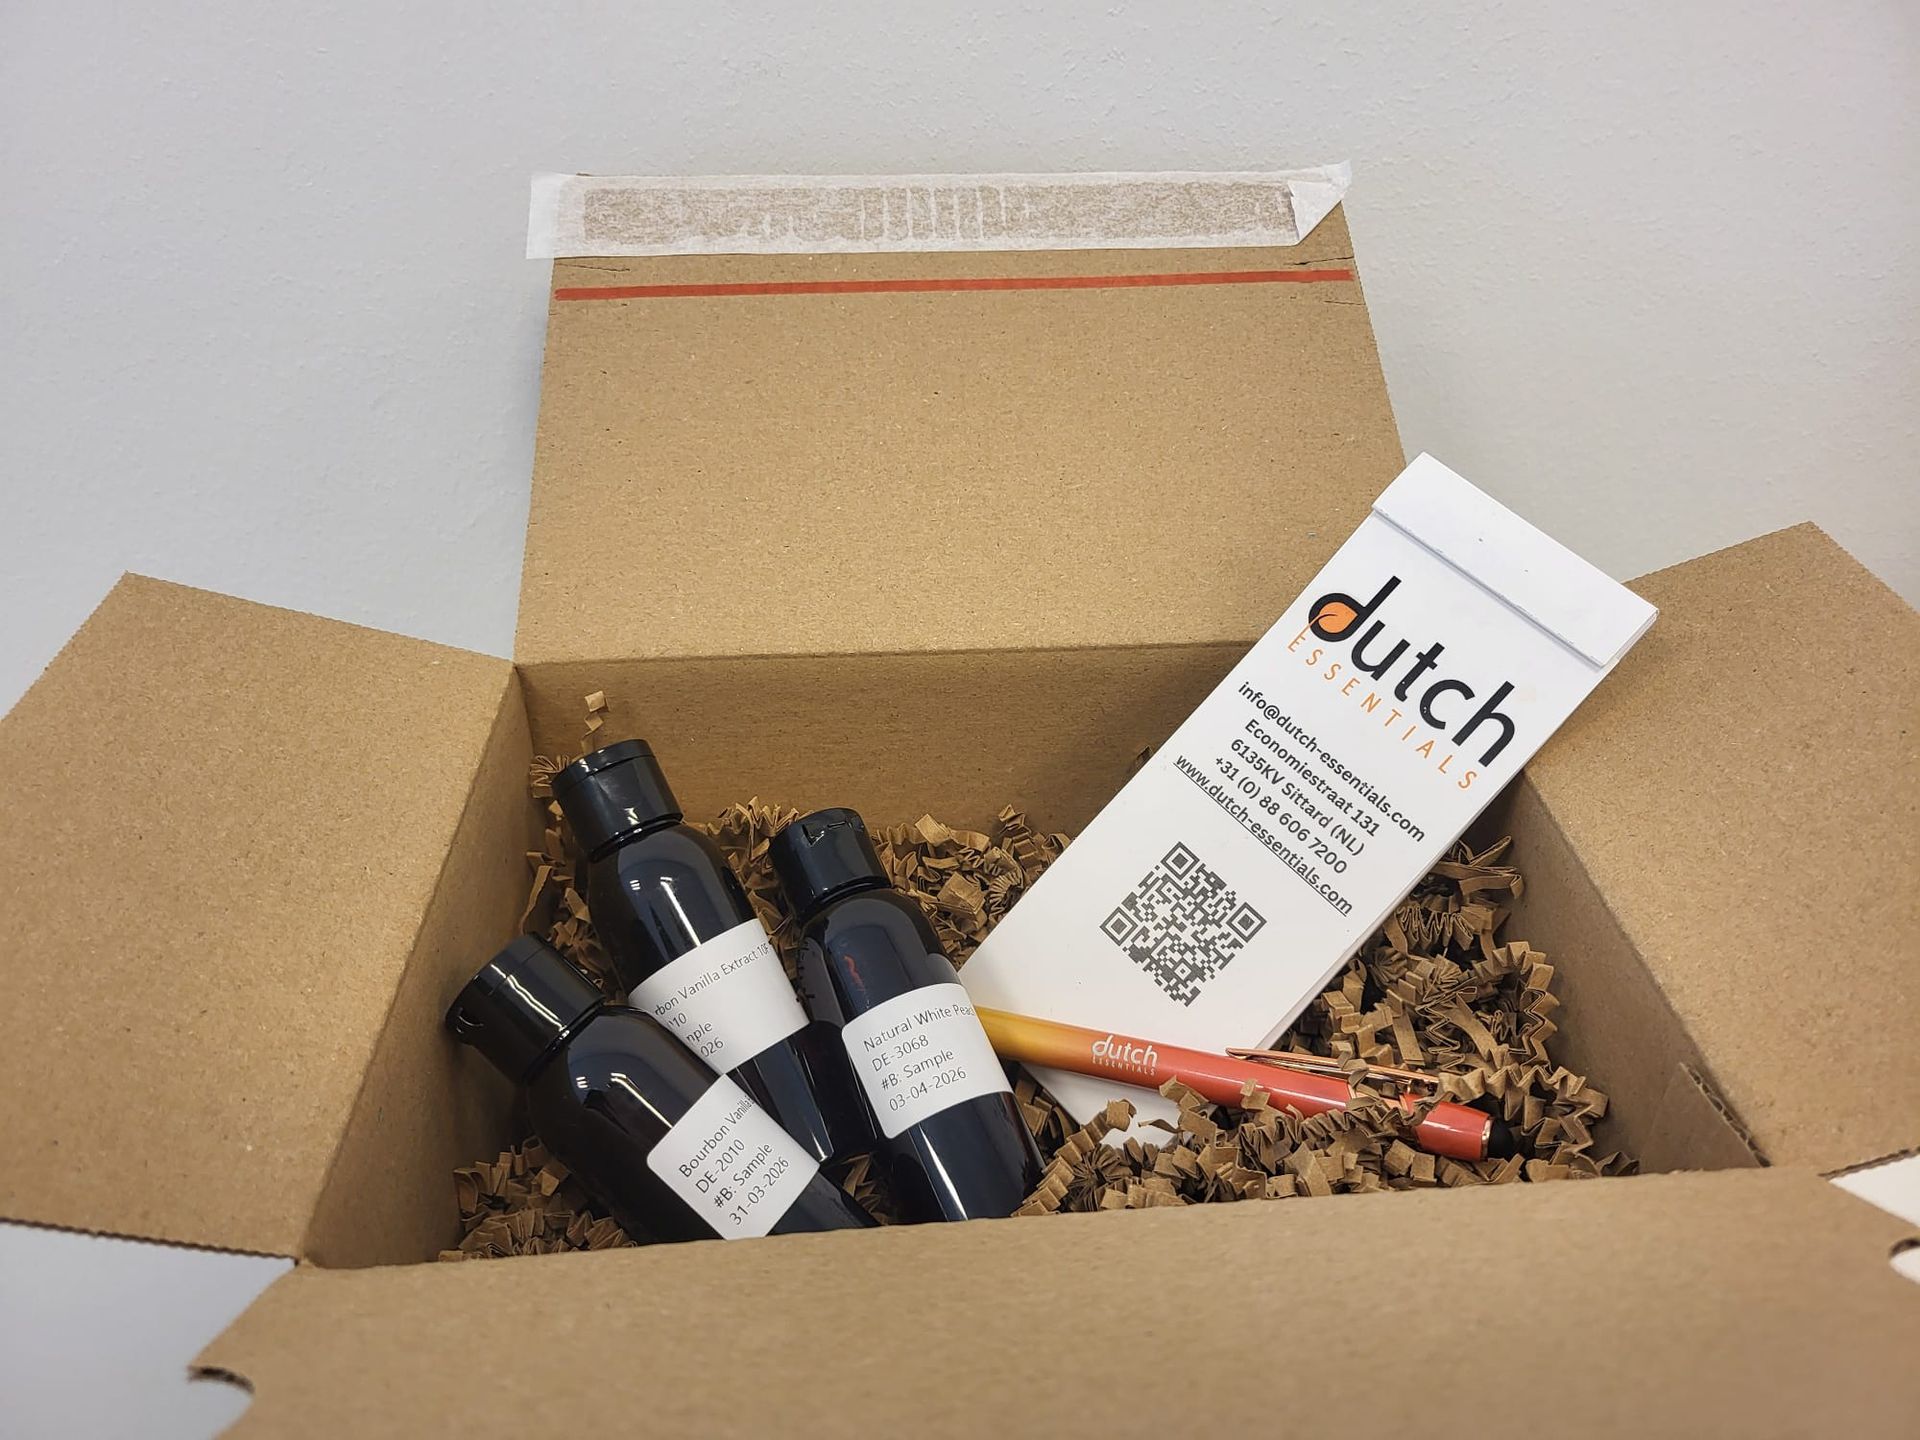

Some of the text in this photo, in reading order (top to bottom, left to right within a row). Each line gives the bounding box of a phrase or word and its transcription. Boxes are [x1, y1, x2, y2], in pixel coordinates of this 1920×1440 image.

[1308, 575, 1515, 767] dutch
[1287, 633, 1477, 789] ESSENTIALS
[1238, 681, 1425, 842] info@dutch-essentials.com
[1245, 719, 1381, 837] Economiestraat 131
[1215, 756, 1348, 874] +31 (0) 88 606 7200
[1231, 738, 1366, 857] 6135KV Sittard (NL)
[1174, 755, 1353, 916] www.dutch-essentials.com
[655, 997, 679, 1016] rbon
[677, 972, 721, 999] Vanilla
[720, 950, 758, 976] Extract
[863, 1004, 975, 1052] Natural White Peac
[872, 1034, 929, 1072] DE-3068
[1092, 1034, 1158, 1067] dutch
[881, 1050, 954, 1091] #B: Sample
[889, 1066, 967, 1112] 03-04-2026
[679, 1125, 730, 1178] Bourbon
[695, 1139, 745, 1194] DE-2010
[713, 1143, 773, 1208] #B: Sample
[729, 1156, 789, 1226] 31-03-2026
